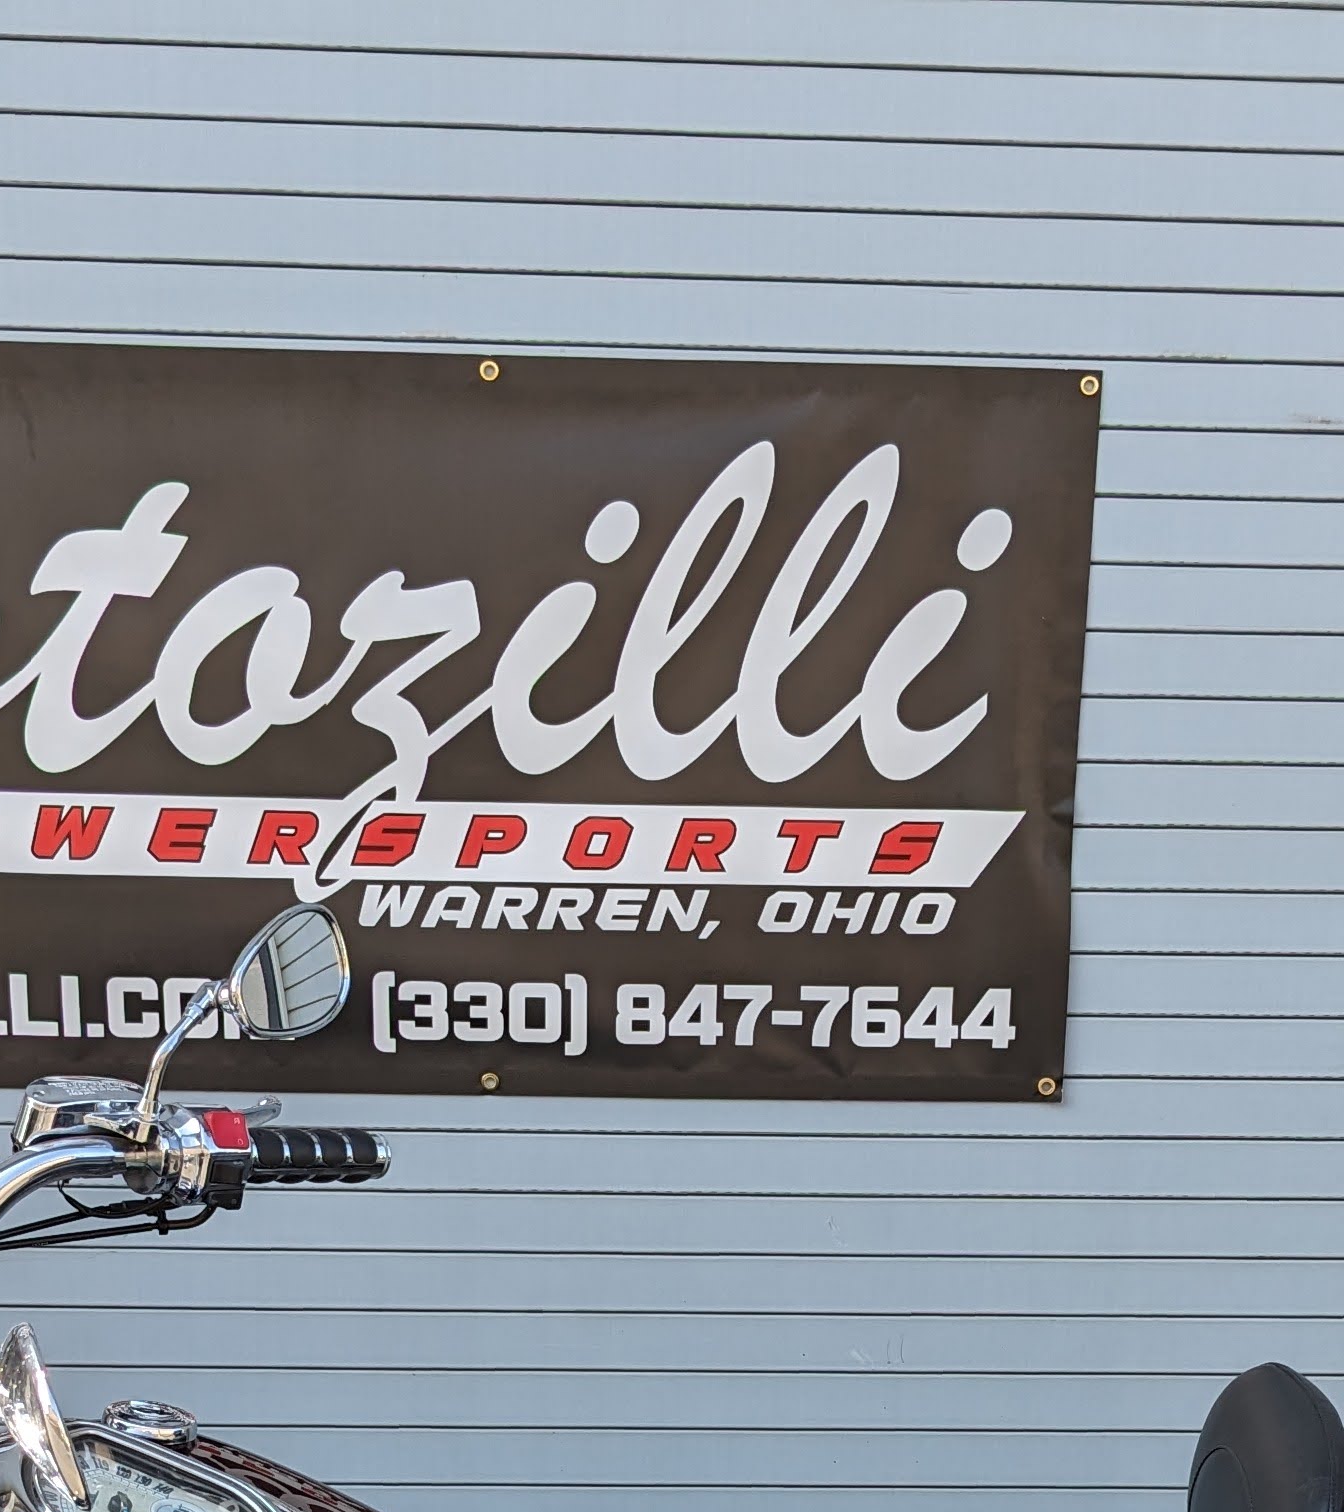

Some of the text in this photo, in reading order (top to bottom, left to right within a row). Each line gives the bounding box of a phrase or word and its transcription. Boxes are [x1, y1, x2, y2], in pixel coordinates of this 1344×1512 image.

[359, 885, 956, 939] WARREN, OHIO
[372, 971, 1016, 1056] (330) 847-7644
